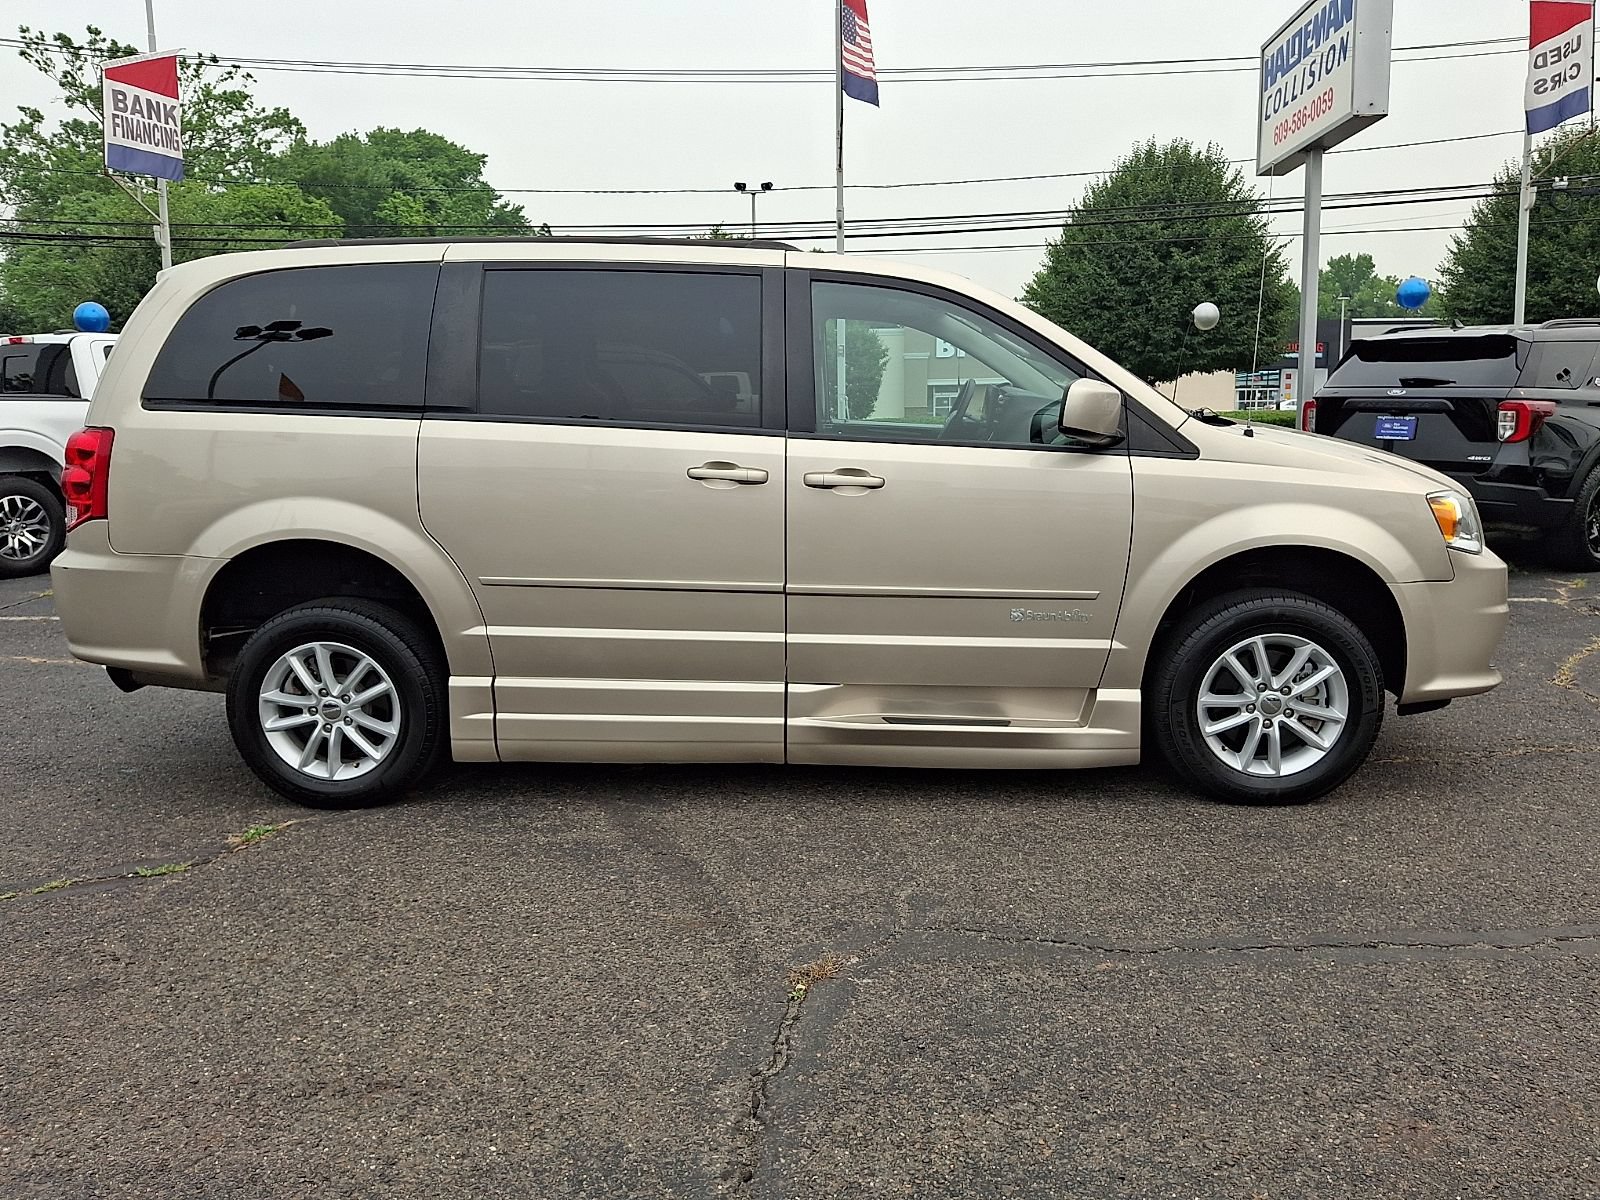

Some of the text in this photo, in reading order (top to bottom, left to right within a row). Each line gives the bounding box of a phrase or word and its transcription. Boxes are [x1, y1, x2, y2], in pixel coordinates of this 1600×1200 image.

[1264, 0, 1353, 93] HALDEMAN
[1264, 31, 1350, 121] COLLISION
[112, 88, 178, 127] BANK
[112, 113, 180, 152] FINANCING
[1273, 87, 1334, 146] 609-586-0059
